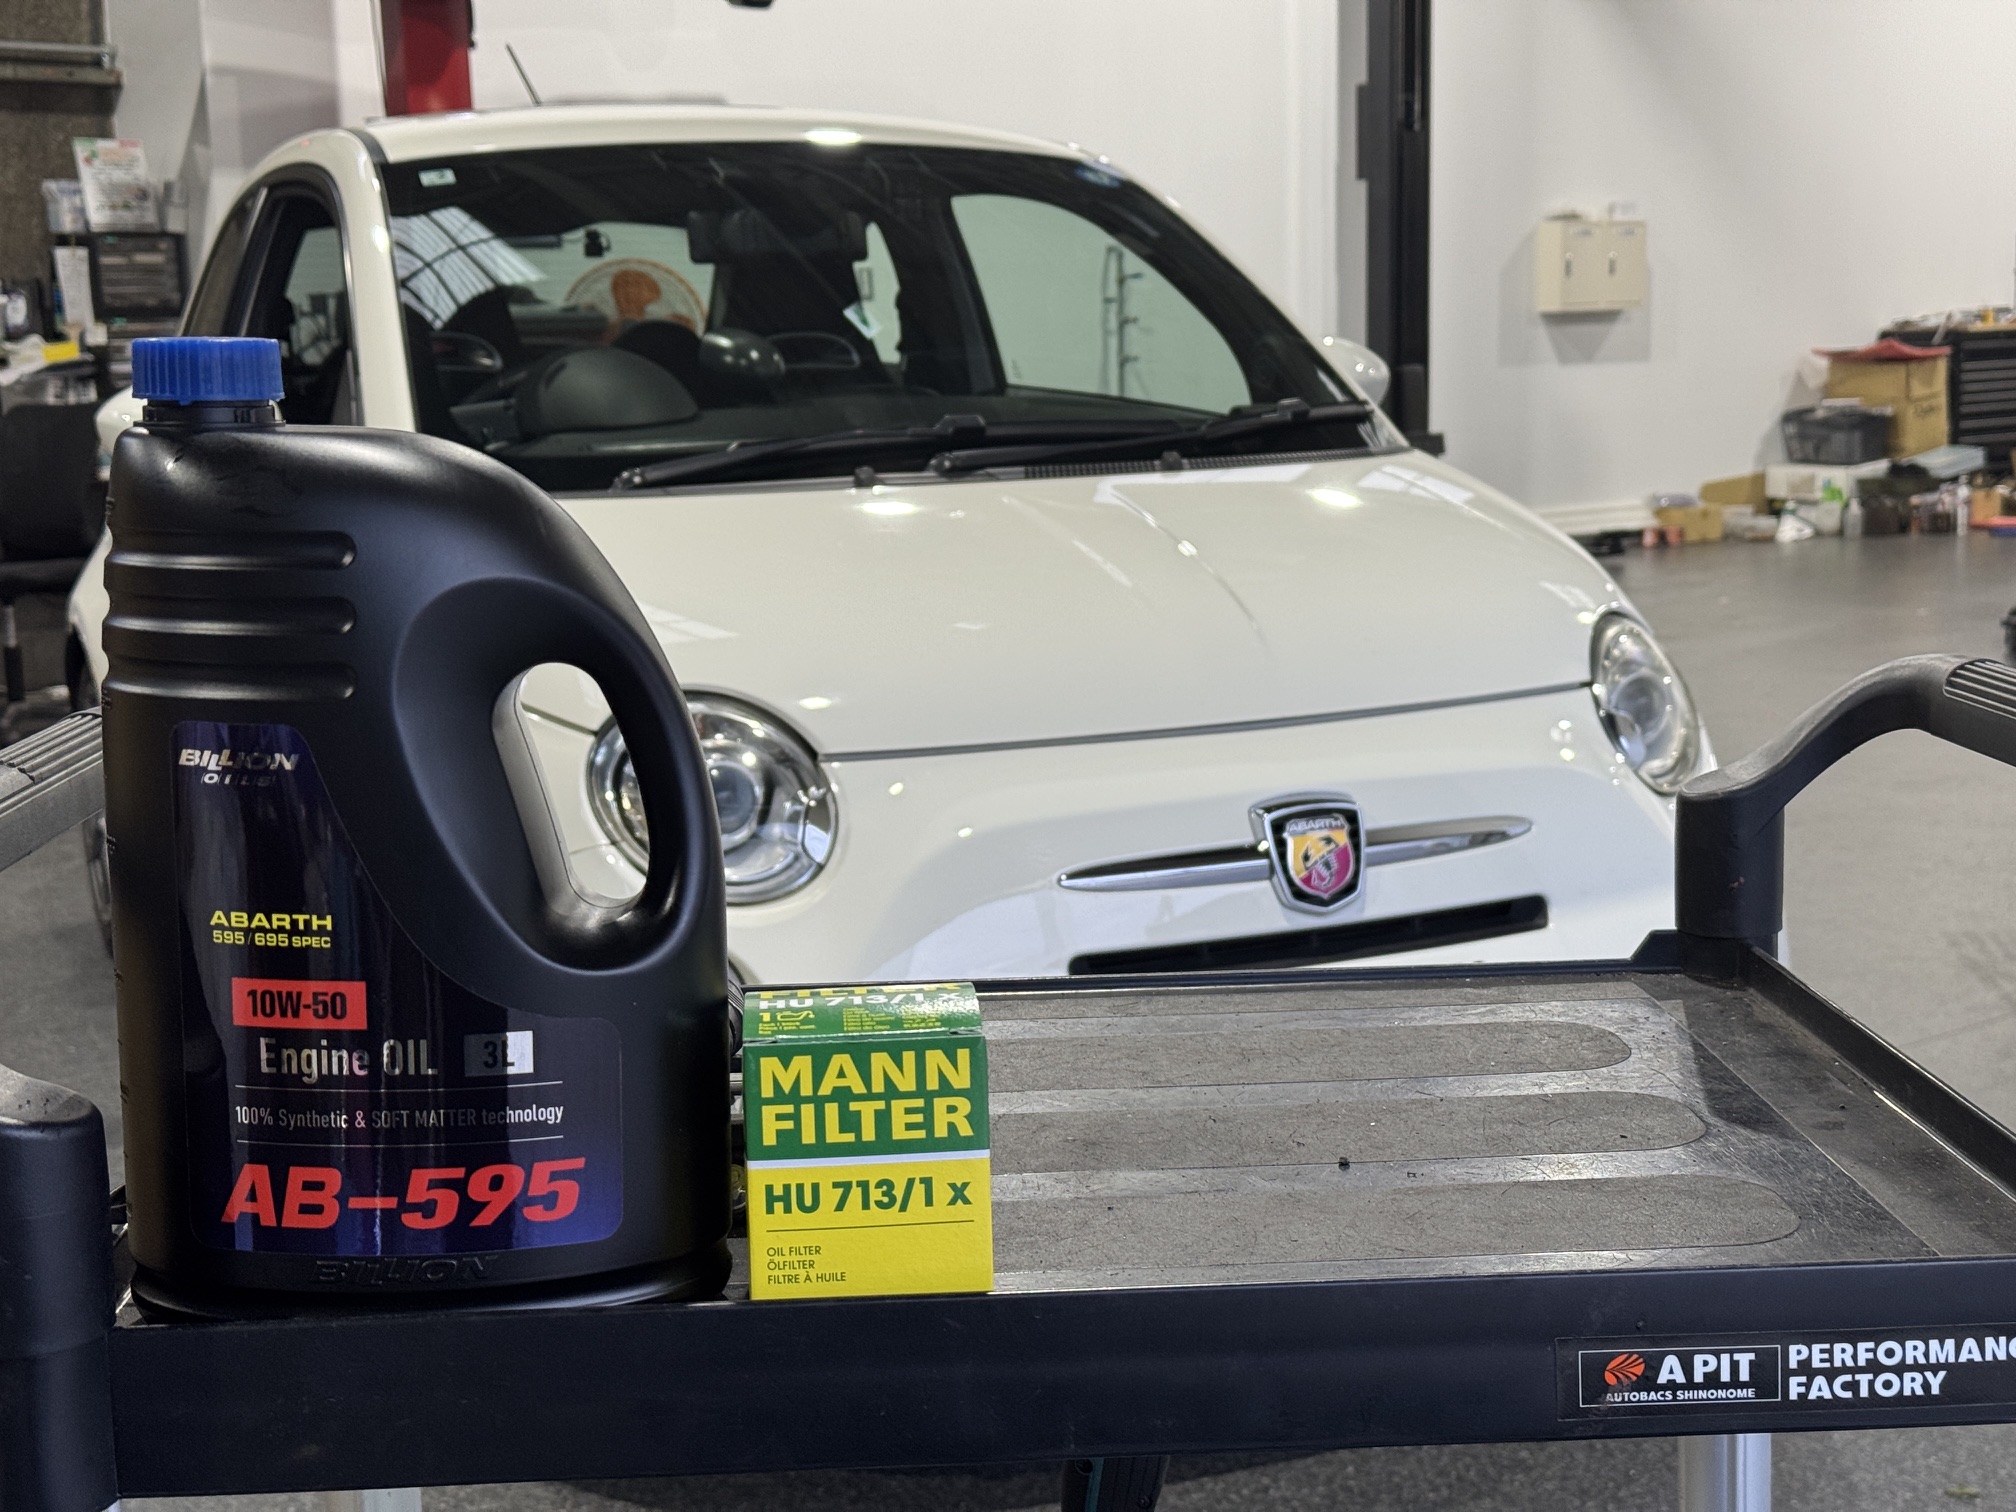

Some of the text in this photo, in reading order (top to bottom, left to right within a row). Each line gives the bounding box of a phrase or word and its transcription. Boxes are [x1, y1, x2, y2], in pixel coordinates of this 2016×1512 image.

[178, 748, 299, 771] BILLION
[1289, 818, 1343, 832] ABARTH
[209, 910, 333, 931] ABARTH
[291, 935, 332, 948] SPEC
[246, 989, 347, 1020] 10W-50
[759, 997, 814, 1010] HU
[824, 992, 924, 1007] 713/1
[259, 1036, 439, 1085] Engine OIL
[482, 1032, 515, 1069] 3L
[760, 1048, 971, 1098] MANN
[235, 1104, 564, 1130] 100% Synthetic & SOFT MATTER technology
[761, 1096, 975, 1146] FILTER
[221, 1156, 587, 1231] AB-595
[765, 1181, 821, 1215] HU
[832, 1176, 934, 1213] 713/1
[766, 1245, 822, 1257] OIL FILTER
[766, 1258, 815, 1271] ÖLFILTER
[767, 1270, 847, 1285] FILTRE À HUILE
[1605, 1388, 1756, 1402] AUTOBACS SHINONOME
[1788, 1371, 1947, 1400] FACTORY
